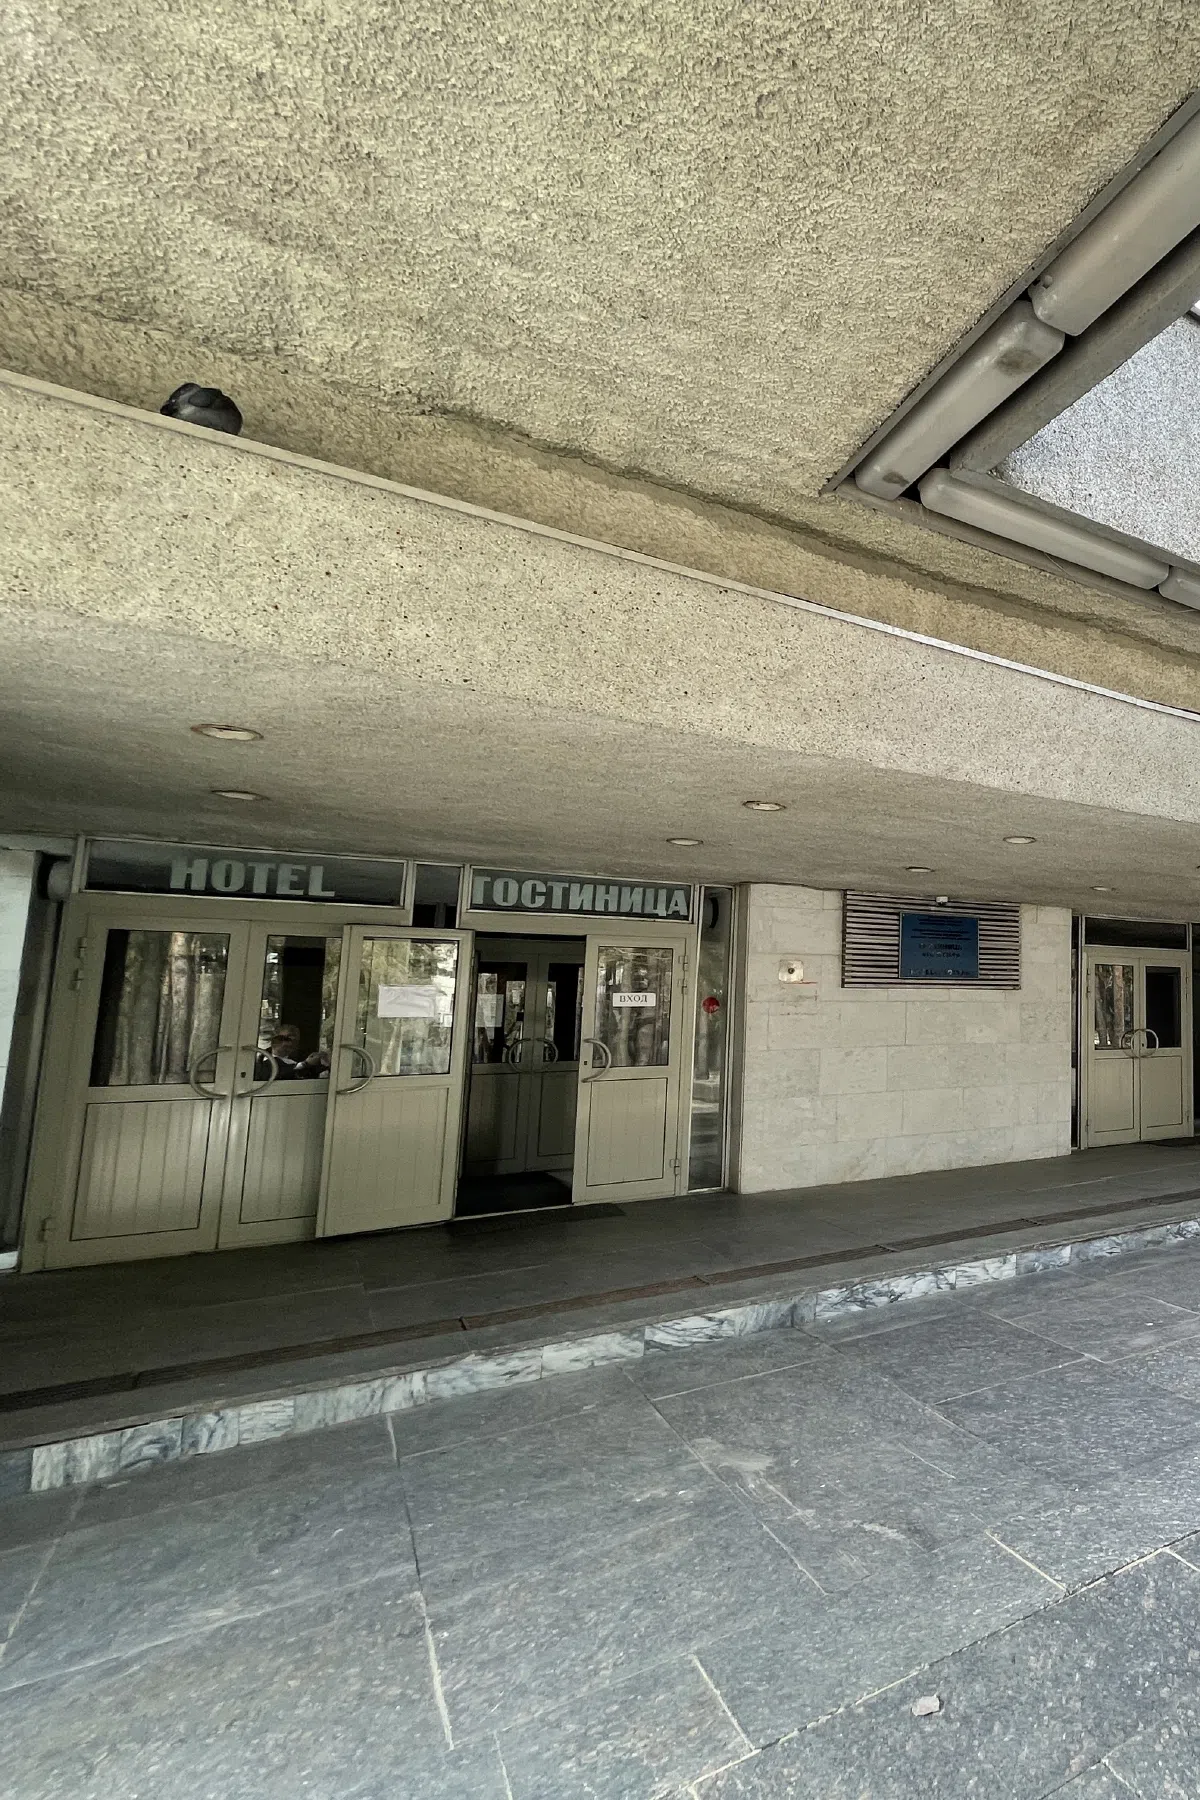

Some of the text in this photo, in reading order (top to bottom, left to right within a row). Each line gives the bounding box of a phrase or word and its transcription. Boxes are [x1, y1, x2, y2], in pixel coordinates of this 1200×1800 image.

[170, 856, 336, 897] HOTEL
[472, 876, 689, 917] ГОСТИНИЦА
[619, 994, 648, 1003] ВХОД
